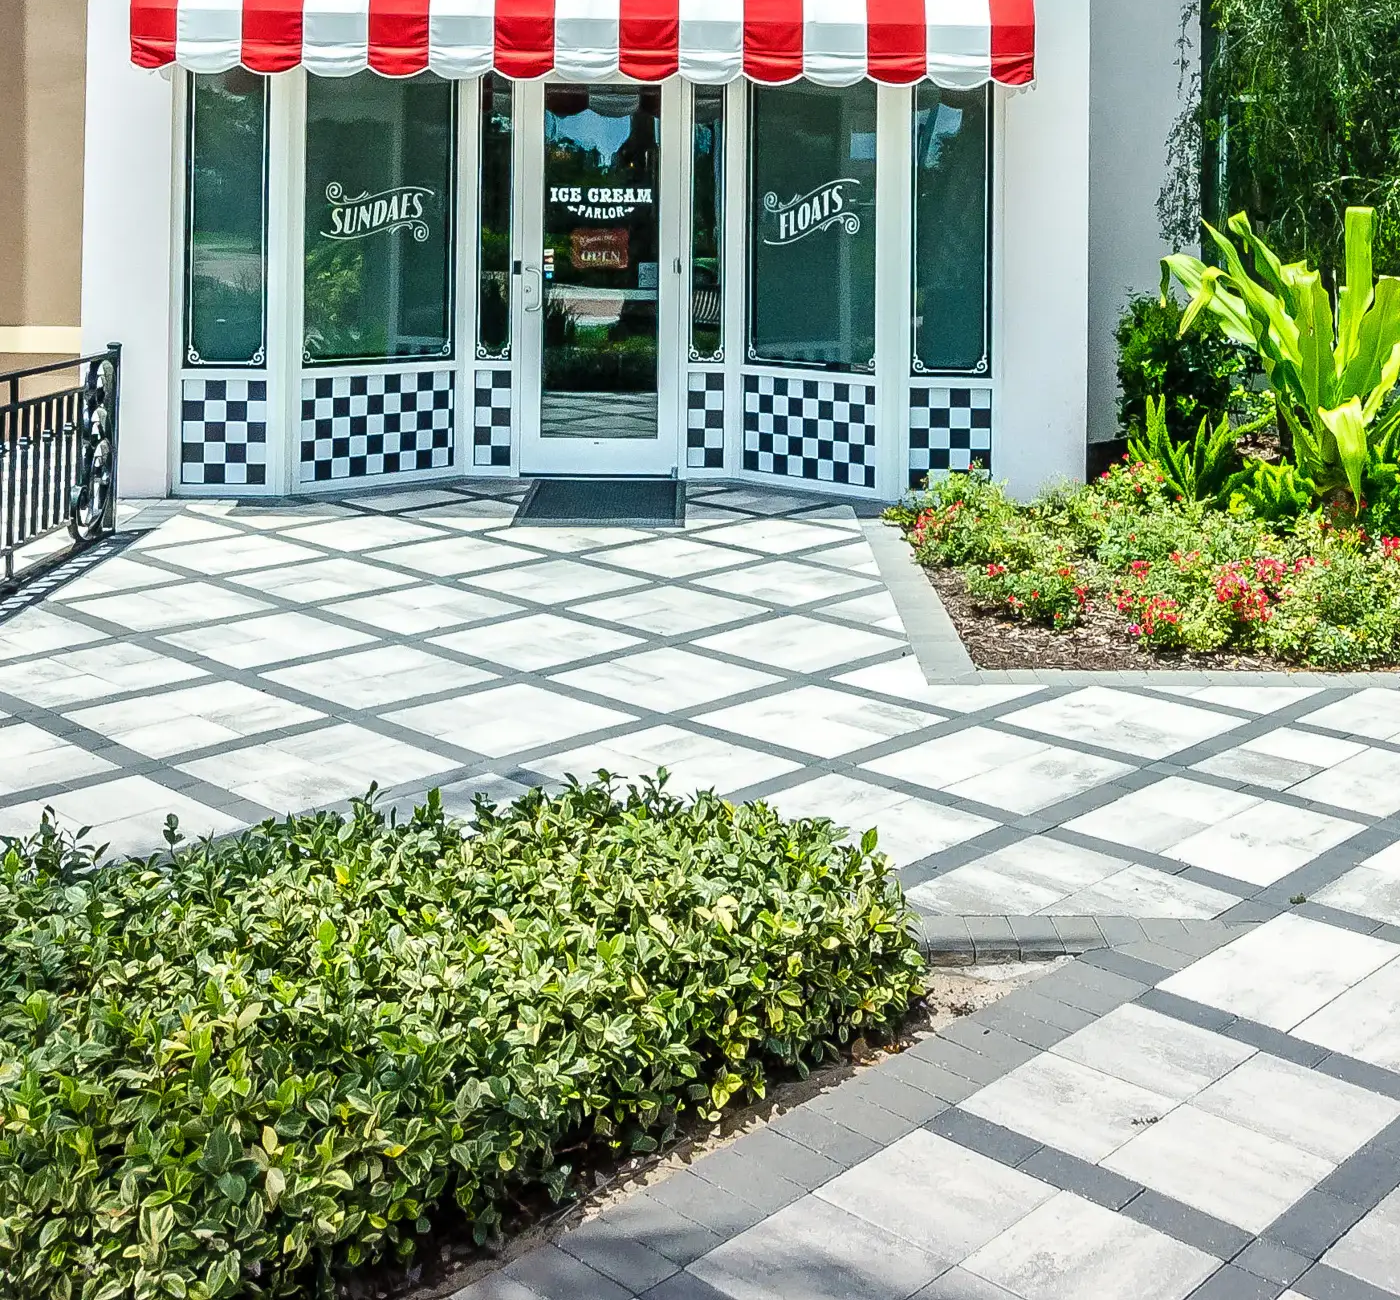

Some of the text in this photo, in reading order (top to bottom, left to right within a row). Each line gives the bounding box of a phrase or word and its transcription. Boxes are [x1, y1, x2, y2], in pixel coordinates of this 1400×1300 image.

[550, 187, 652, 203] ICE CREAM
[330, 192, 424, 235] SUNDAES
[577, 205, 624, 219] PARLOR
[779, 185, 843, 240] FLOATS
[580, 250, 620, 262] OPEN
